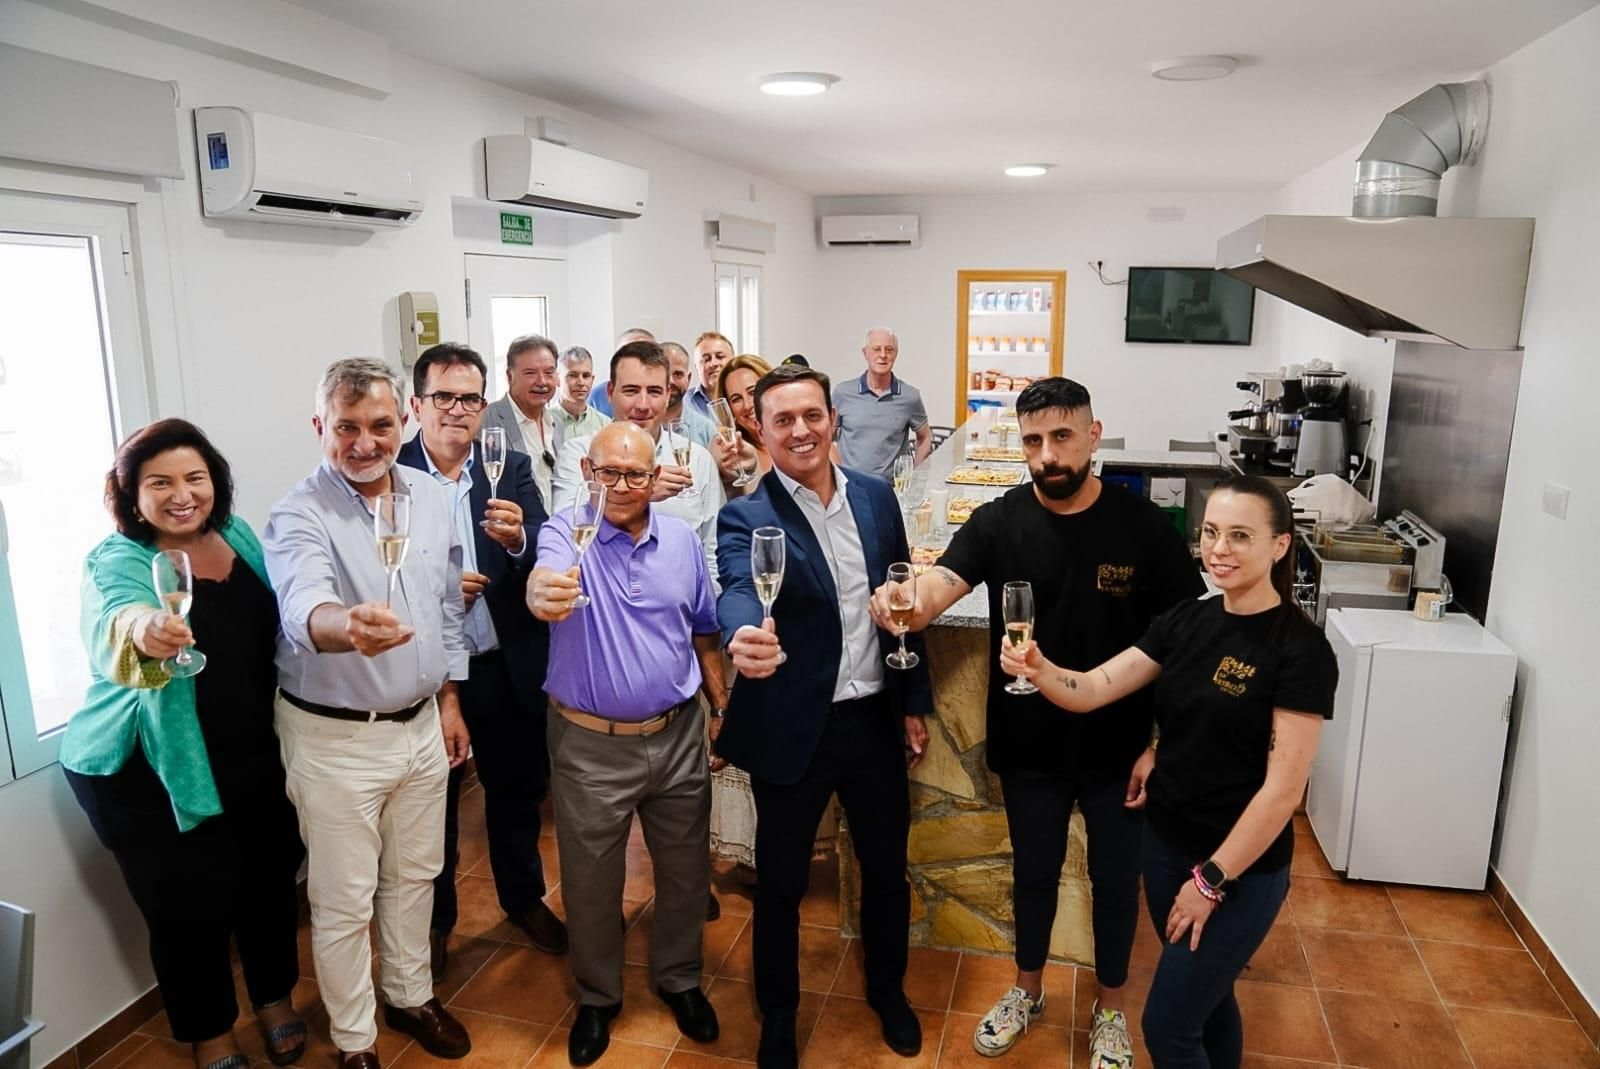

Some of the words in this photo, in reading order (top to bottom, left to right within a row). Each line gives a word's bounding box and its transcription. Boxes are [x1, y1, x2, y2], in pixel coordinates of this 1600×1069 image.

[502, 215, 519, 228] SALIDA
[524, 218, 531, 230] DE
[502, 229, 532, 241] EMERGENCIA
